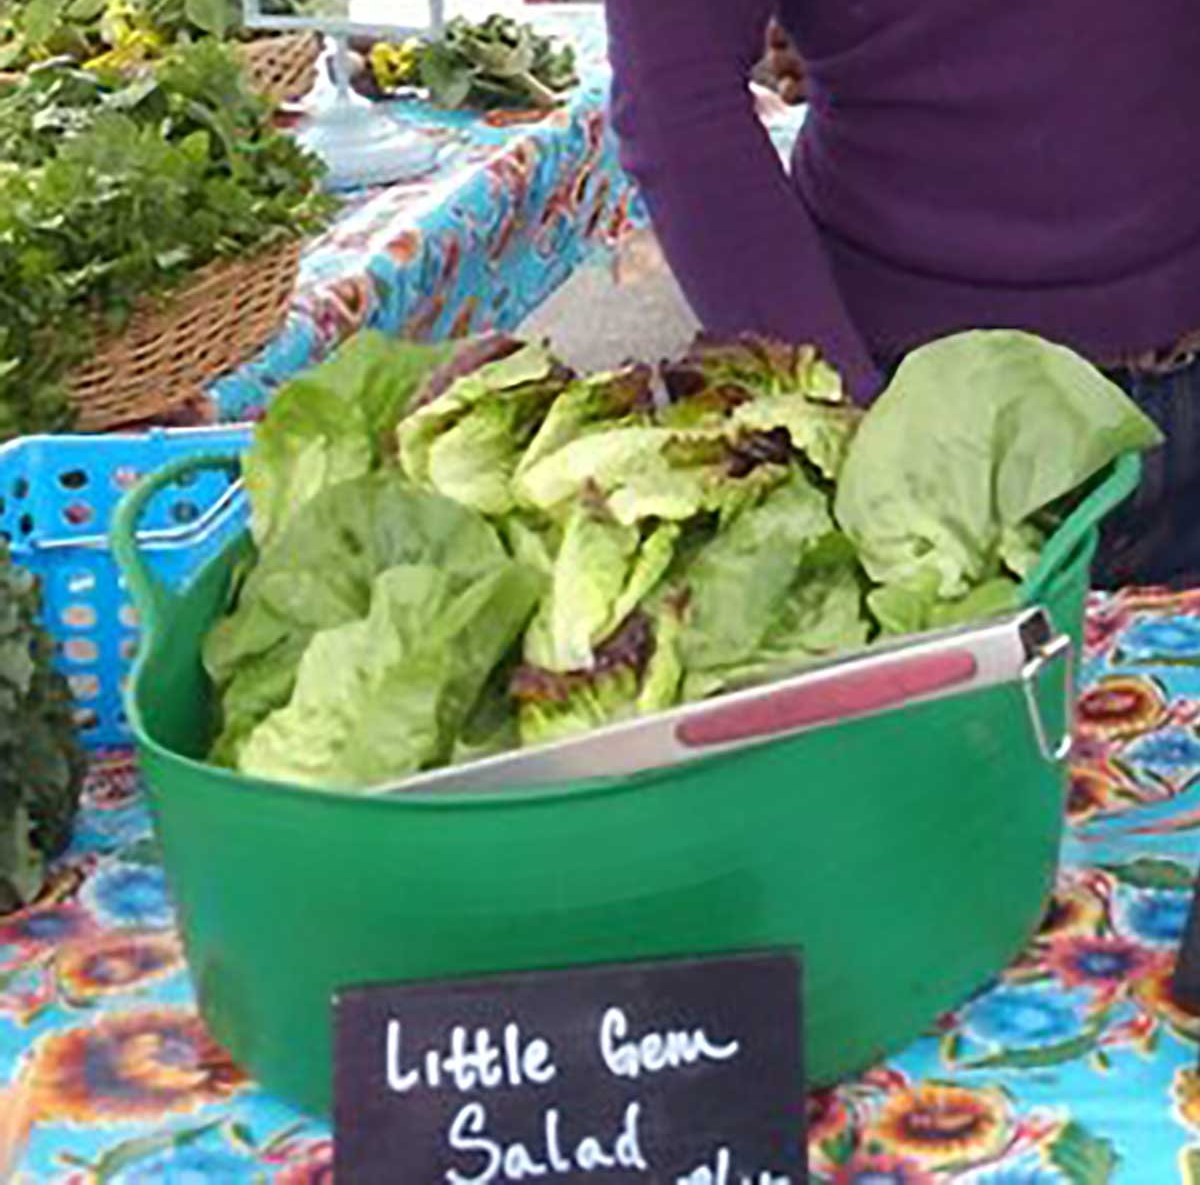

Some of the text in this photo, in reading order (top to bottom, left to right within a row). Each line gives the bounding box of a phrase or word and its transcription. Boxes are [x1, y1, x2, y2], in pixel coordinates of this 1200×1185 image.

[386, 1007, 739, 1092] Little Gem
[445, 1101, 648, 1185] Salad
